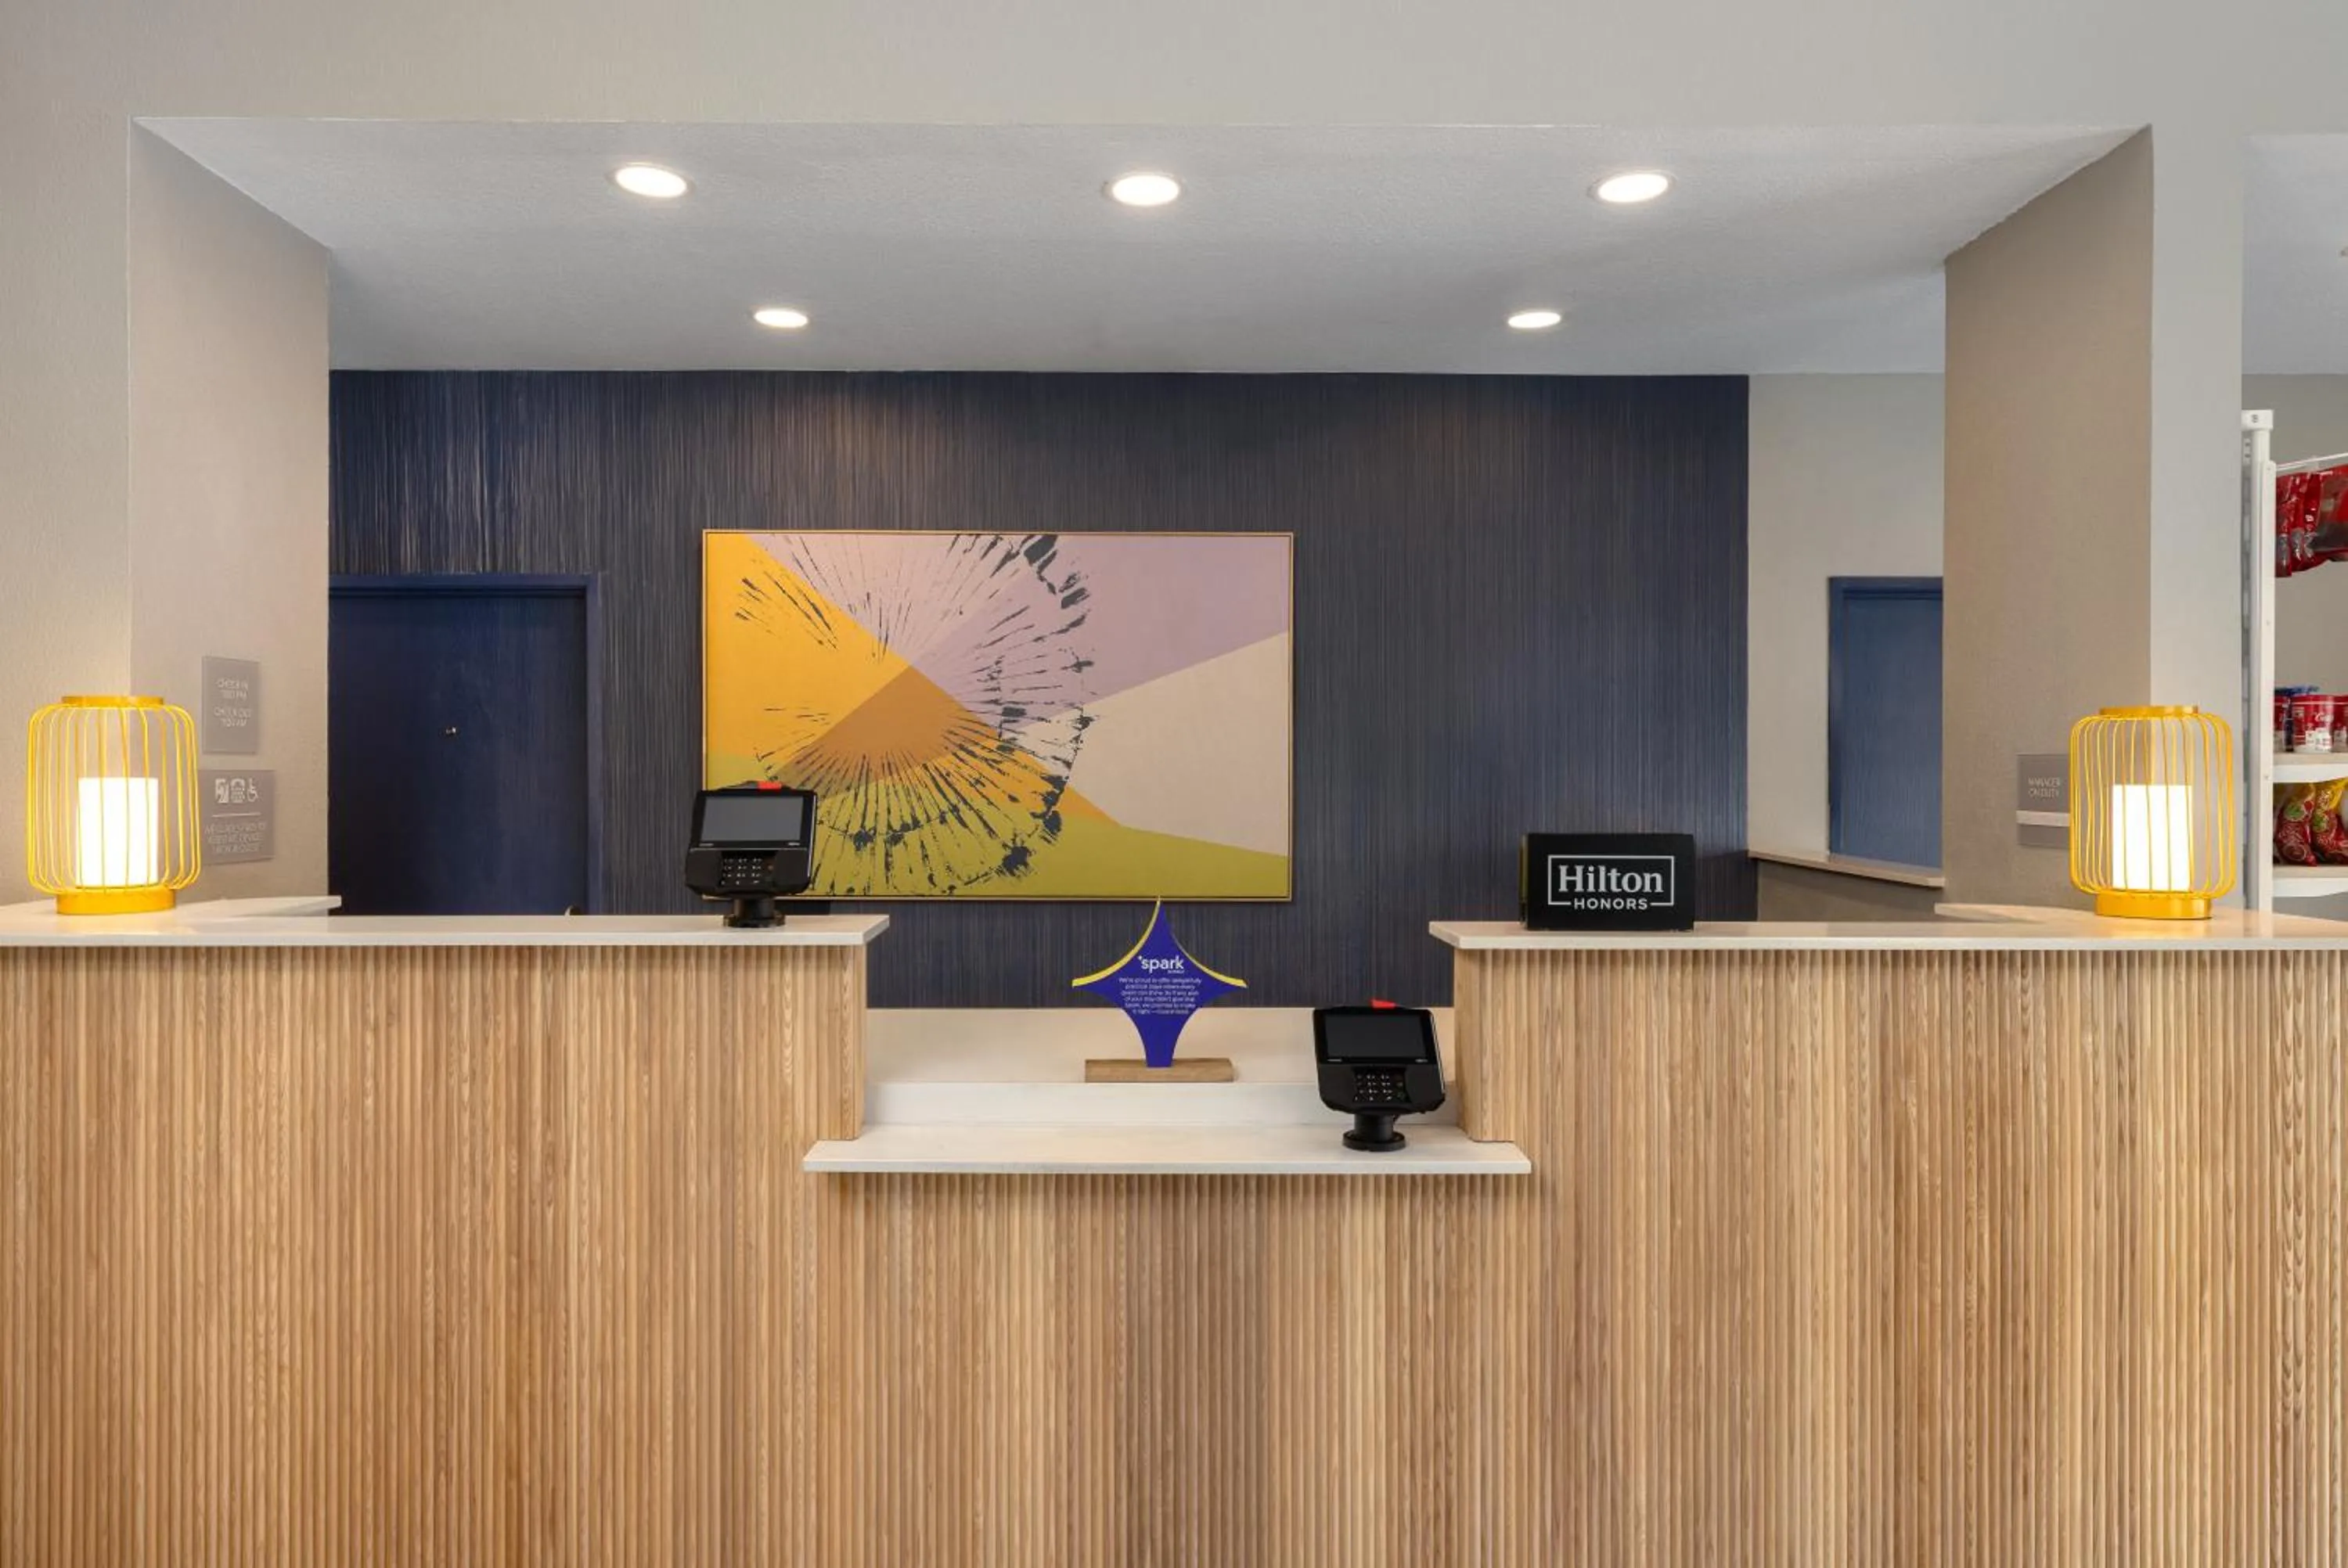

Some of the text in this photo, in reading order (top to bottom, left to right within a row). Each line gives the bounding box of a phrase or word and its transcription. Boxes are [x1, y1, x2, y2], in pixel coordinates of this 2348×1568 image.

[1558, 865, 1664, 893] Hilton
[1574, 898, 1648, 910] HONORS
[1141, 955, 1183, 973] spark
